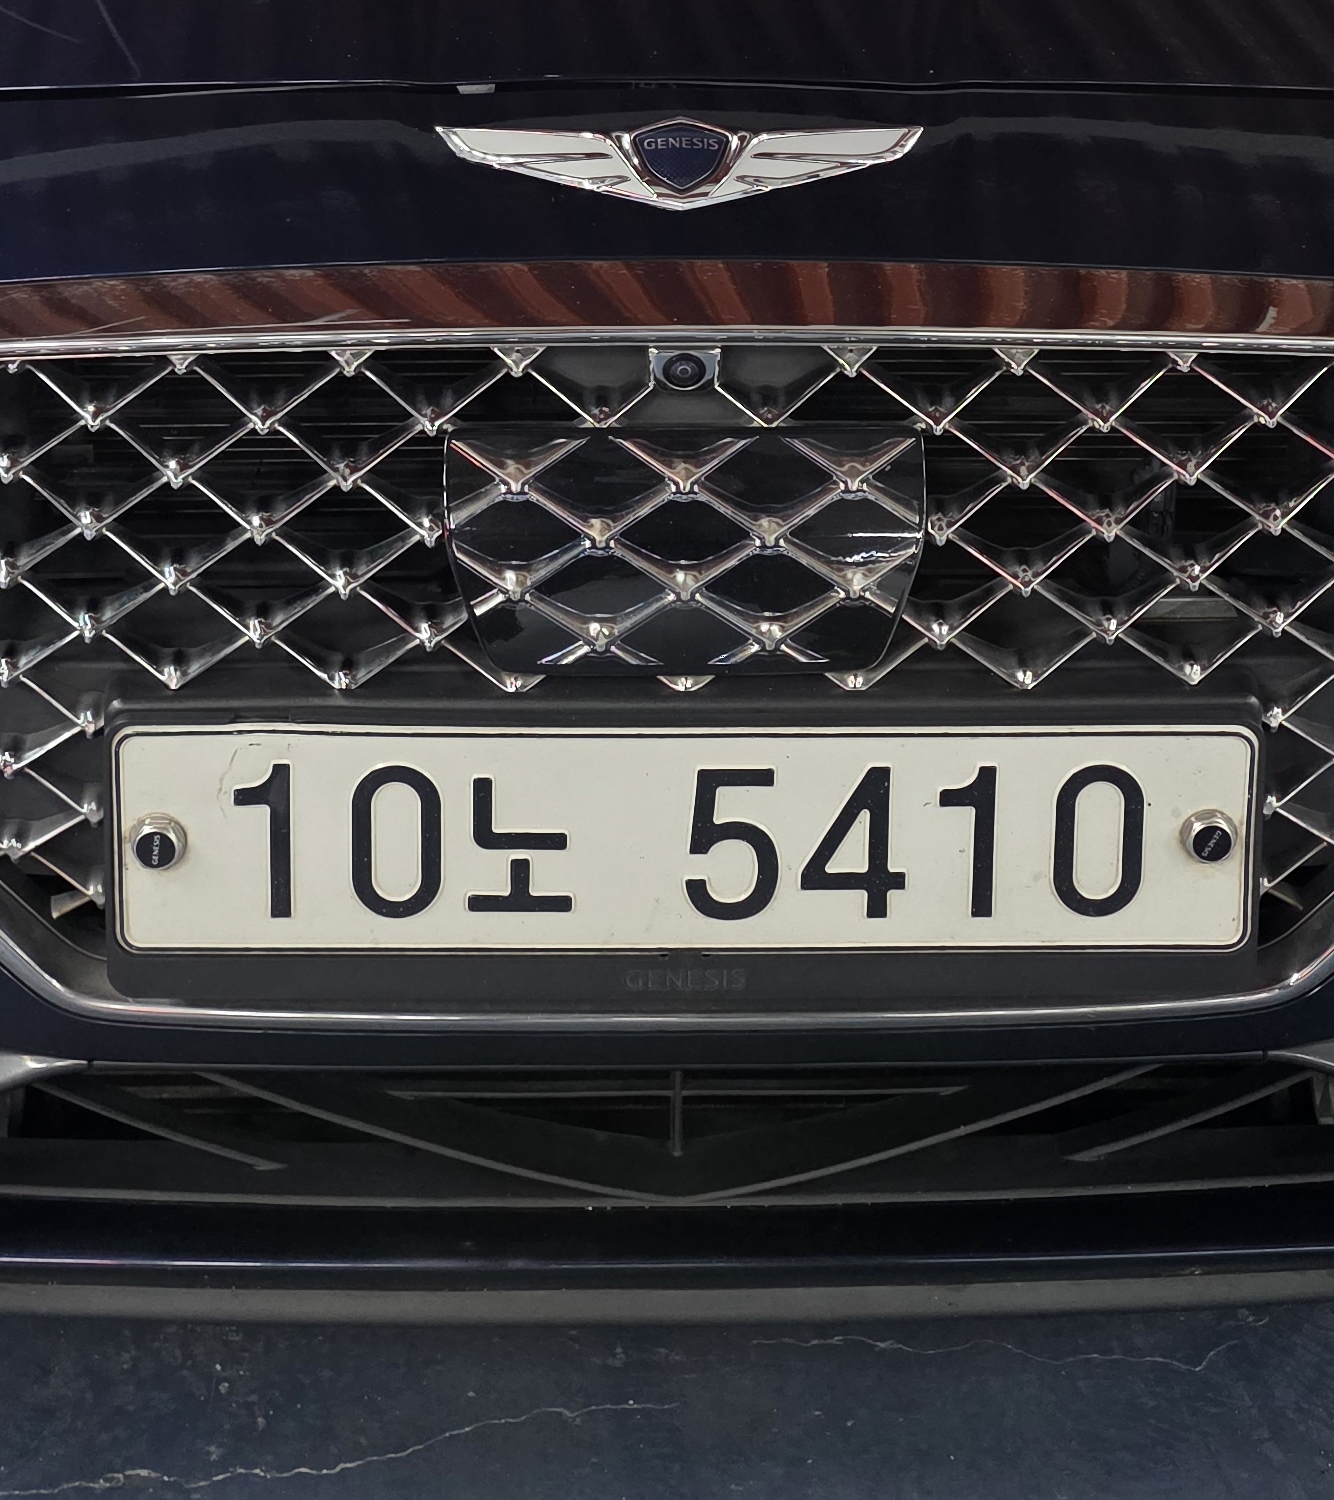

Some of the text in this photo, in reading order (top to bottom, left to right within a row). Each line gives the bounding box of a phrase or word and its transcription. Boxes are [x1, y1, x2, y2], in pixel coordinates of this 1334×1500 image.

[643, 136, 720, 151] GENESIS
[232, 762, 1147, 921] 10노 5410
[624, 968, 748, 992] GENESIS
